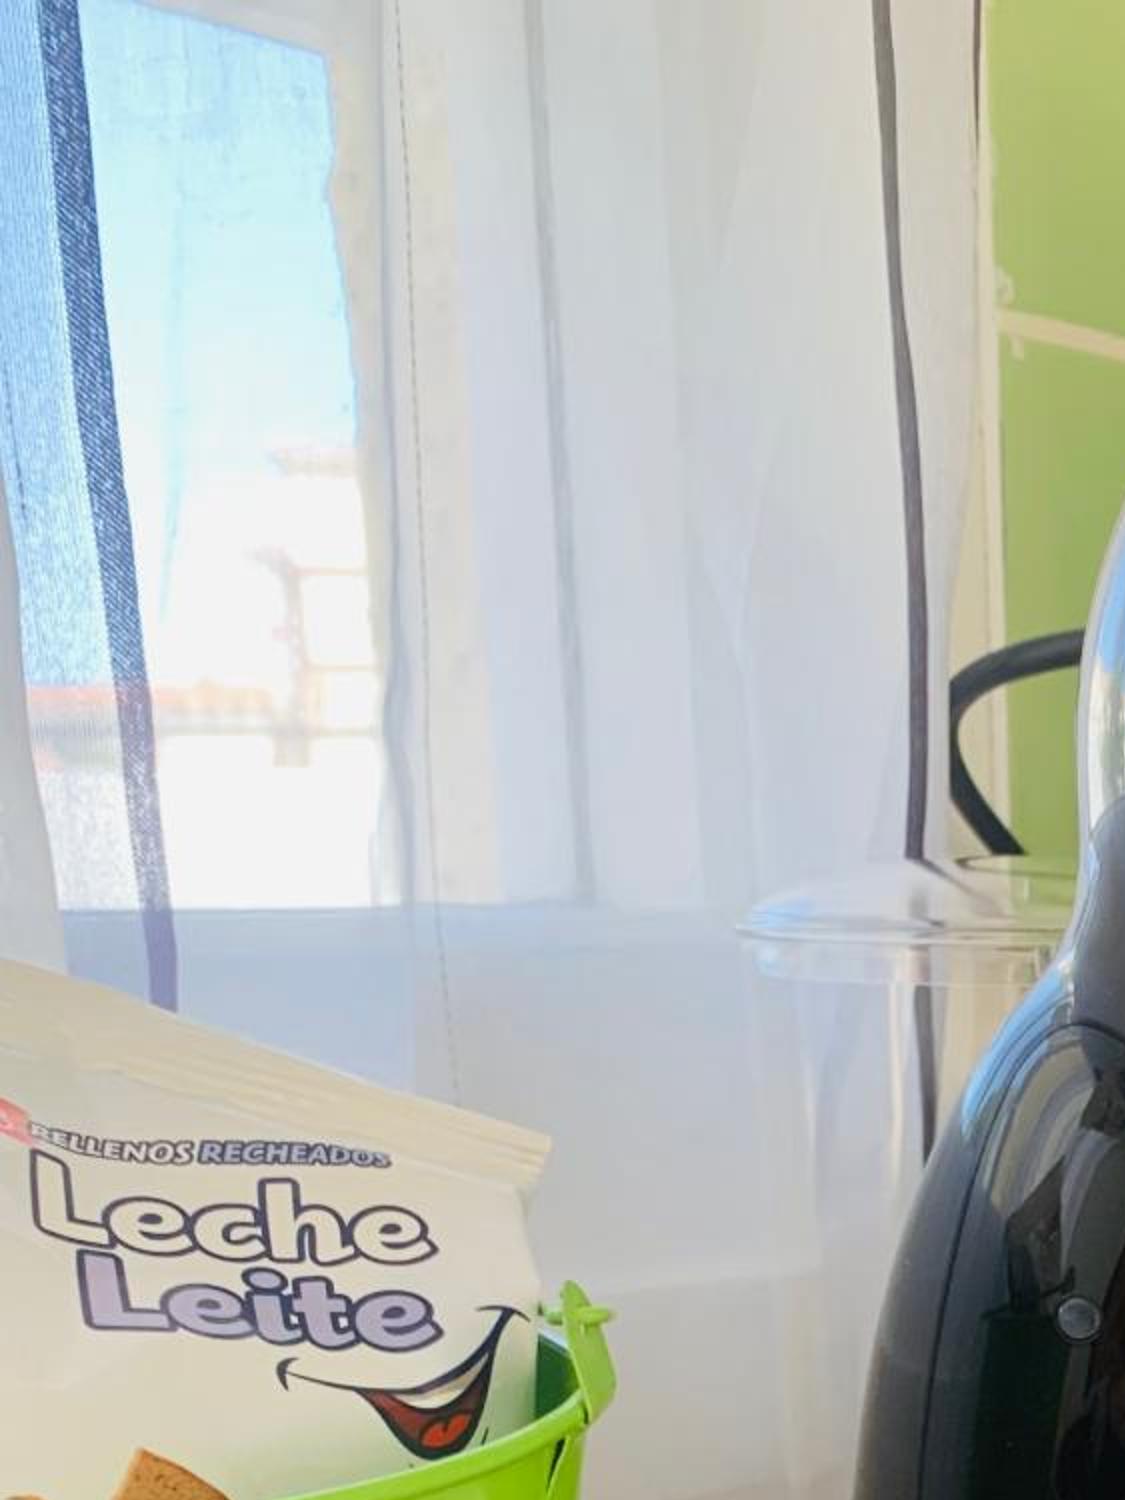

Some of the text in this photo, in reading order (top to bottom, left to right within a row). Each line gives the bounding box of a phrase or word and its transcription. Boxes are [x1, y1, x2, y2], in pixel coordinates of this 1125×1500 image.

[30, 1122, 391, 1168] RELLENOS RECHEADOS
[30, 1149, 439, 1267] Leche
[76, 1249, 444, 1352] Leite
